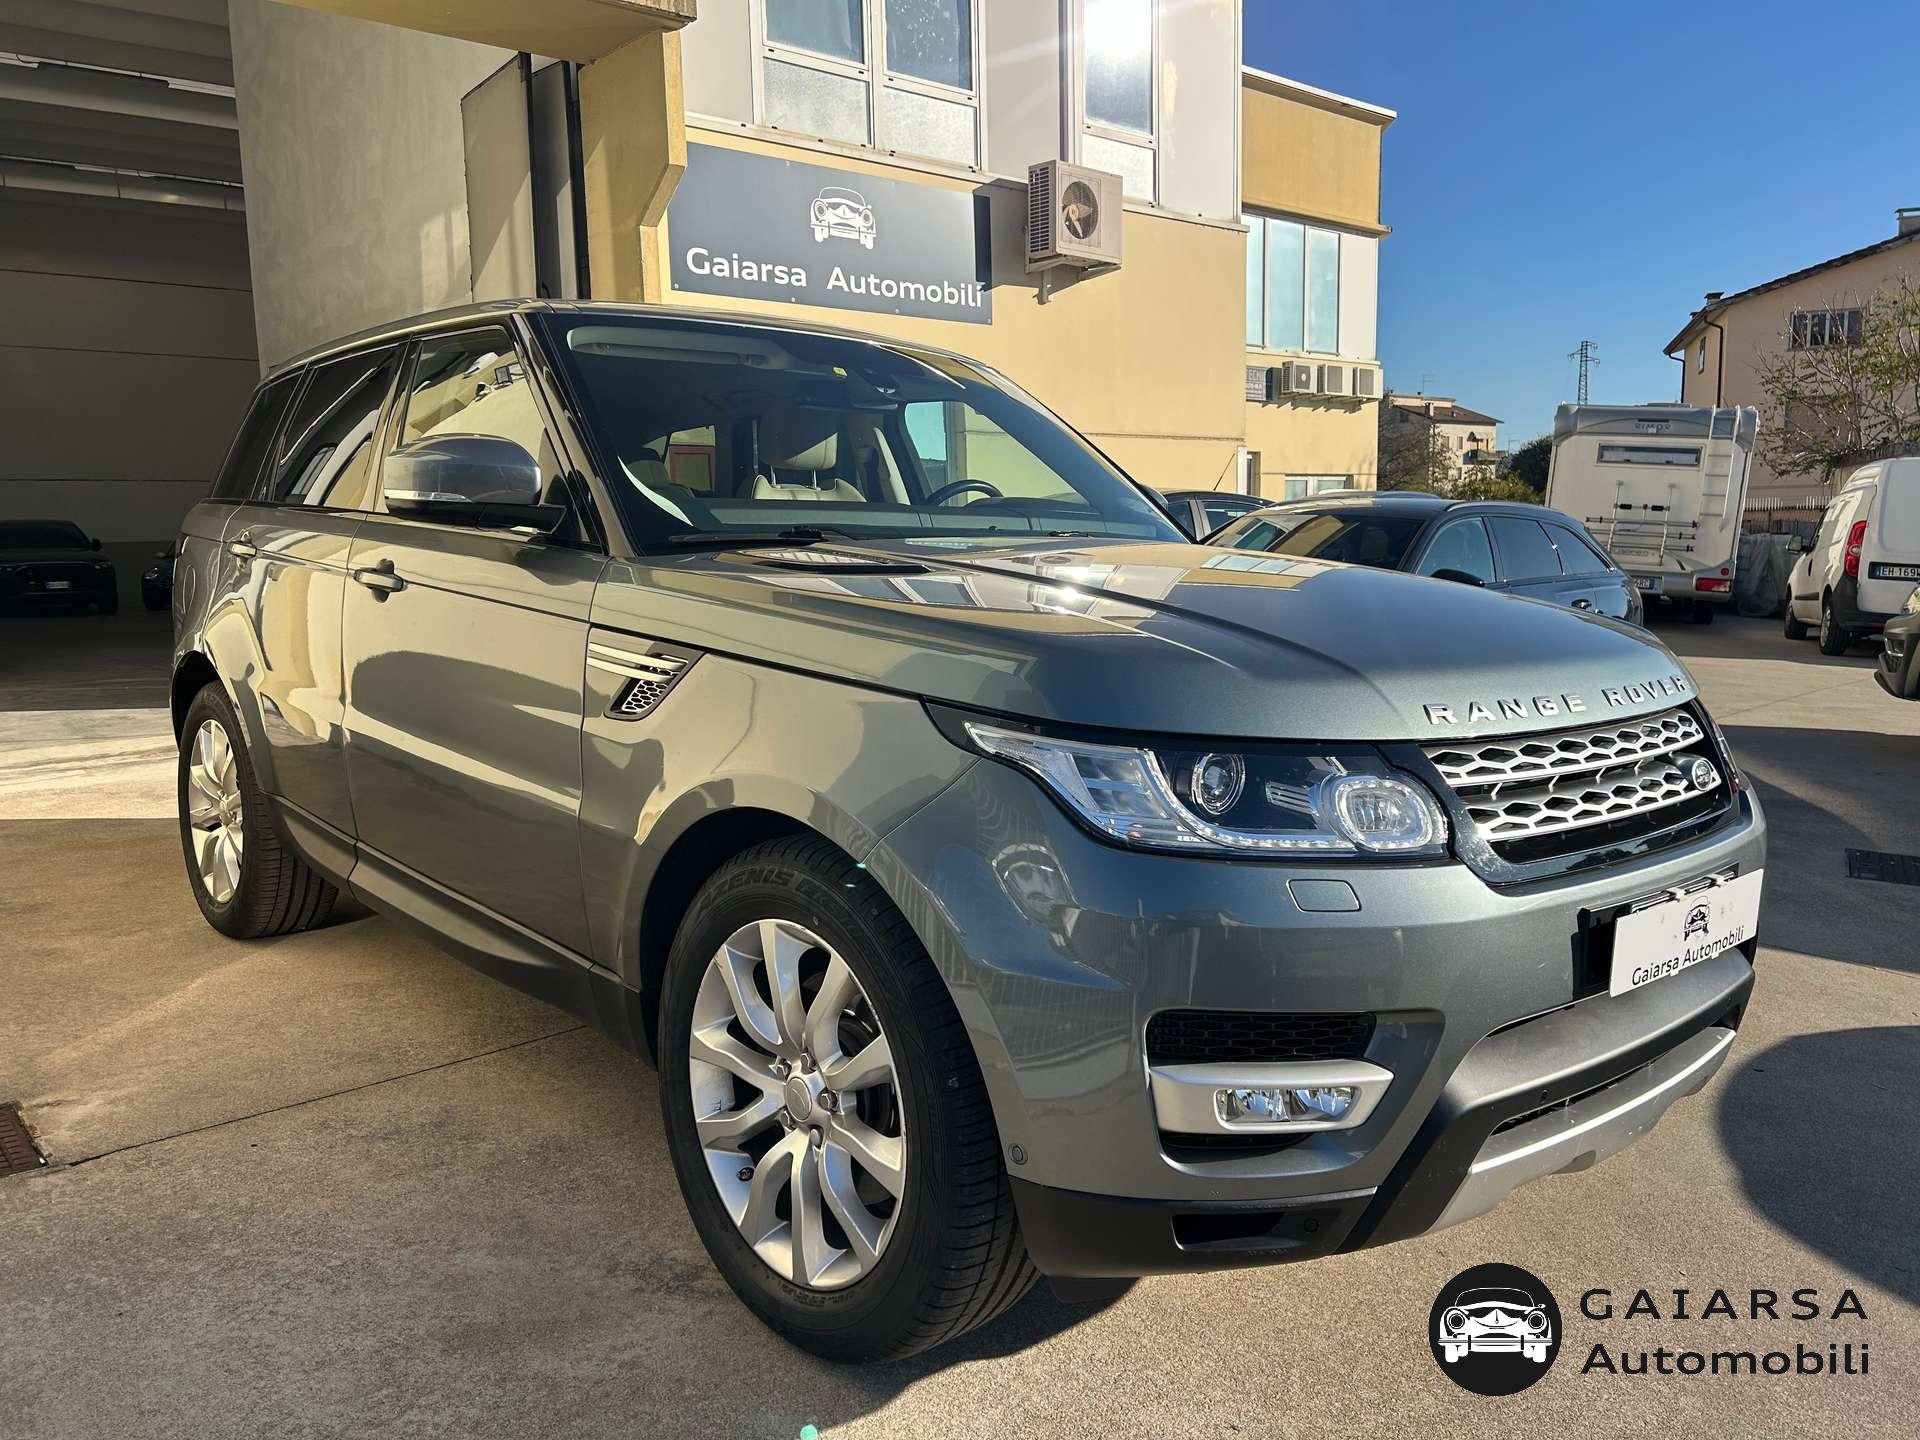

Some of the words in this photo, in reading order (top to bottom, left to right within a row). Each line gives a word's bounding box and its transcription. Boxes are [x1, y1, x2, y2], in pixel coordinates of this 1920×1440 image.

[686, 247, 807, 287] Gaiarsa
[826, 267, 983, 308] Automobili
[1423, 693, 1587, 726] RANGE
[1601, 674, 1688, 708] ROVER
[1631, 956, 1680, 986] Gaiarsa
[1682, 925, 1745, 967] Automobili
